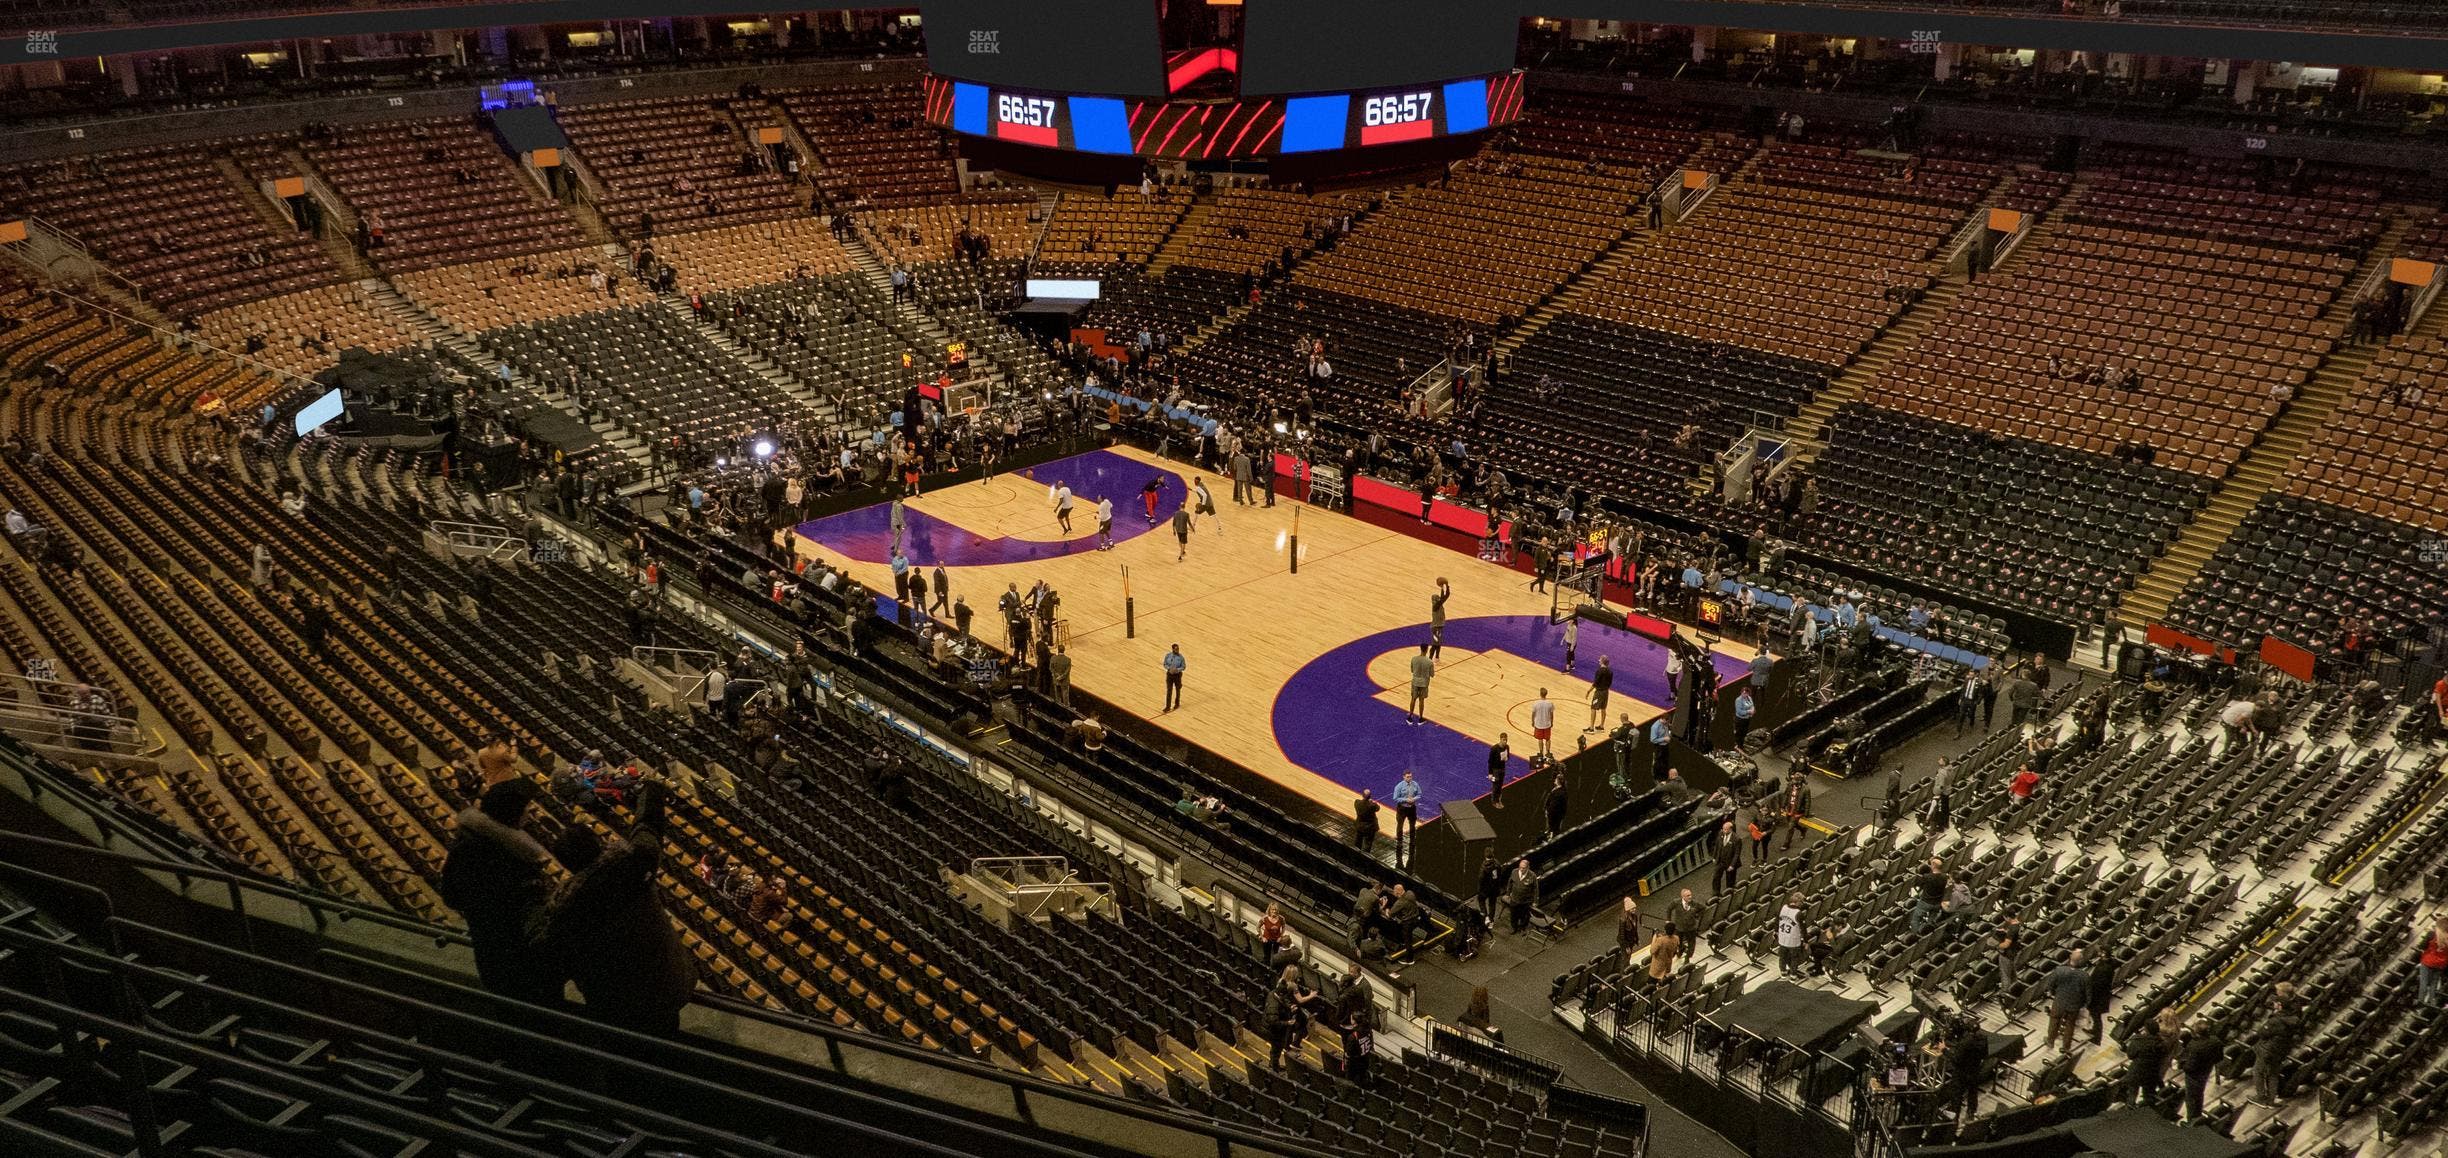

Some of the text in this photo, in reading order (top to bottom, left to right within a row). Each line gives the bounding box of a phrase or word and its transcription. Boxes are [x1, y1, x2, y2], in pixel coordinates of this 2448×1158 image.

[388, 97, 404, 106] 113
[999, 94, 1056, 128] 66:57
[1365, 92, 1432, 127] 66:57
[69, 129, 85, 139] 112
[2246, 138, 2267, 149] 120
[1780, 923, 1792, 934] 43
